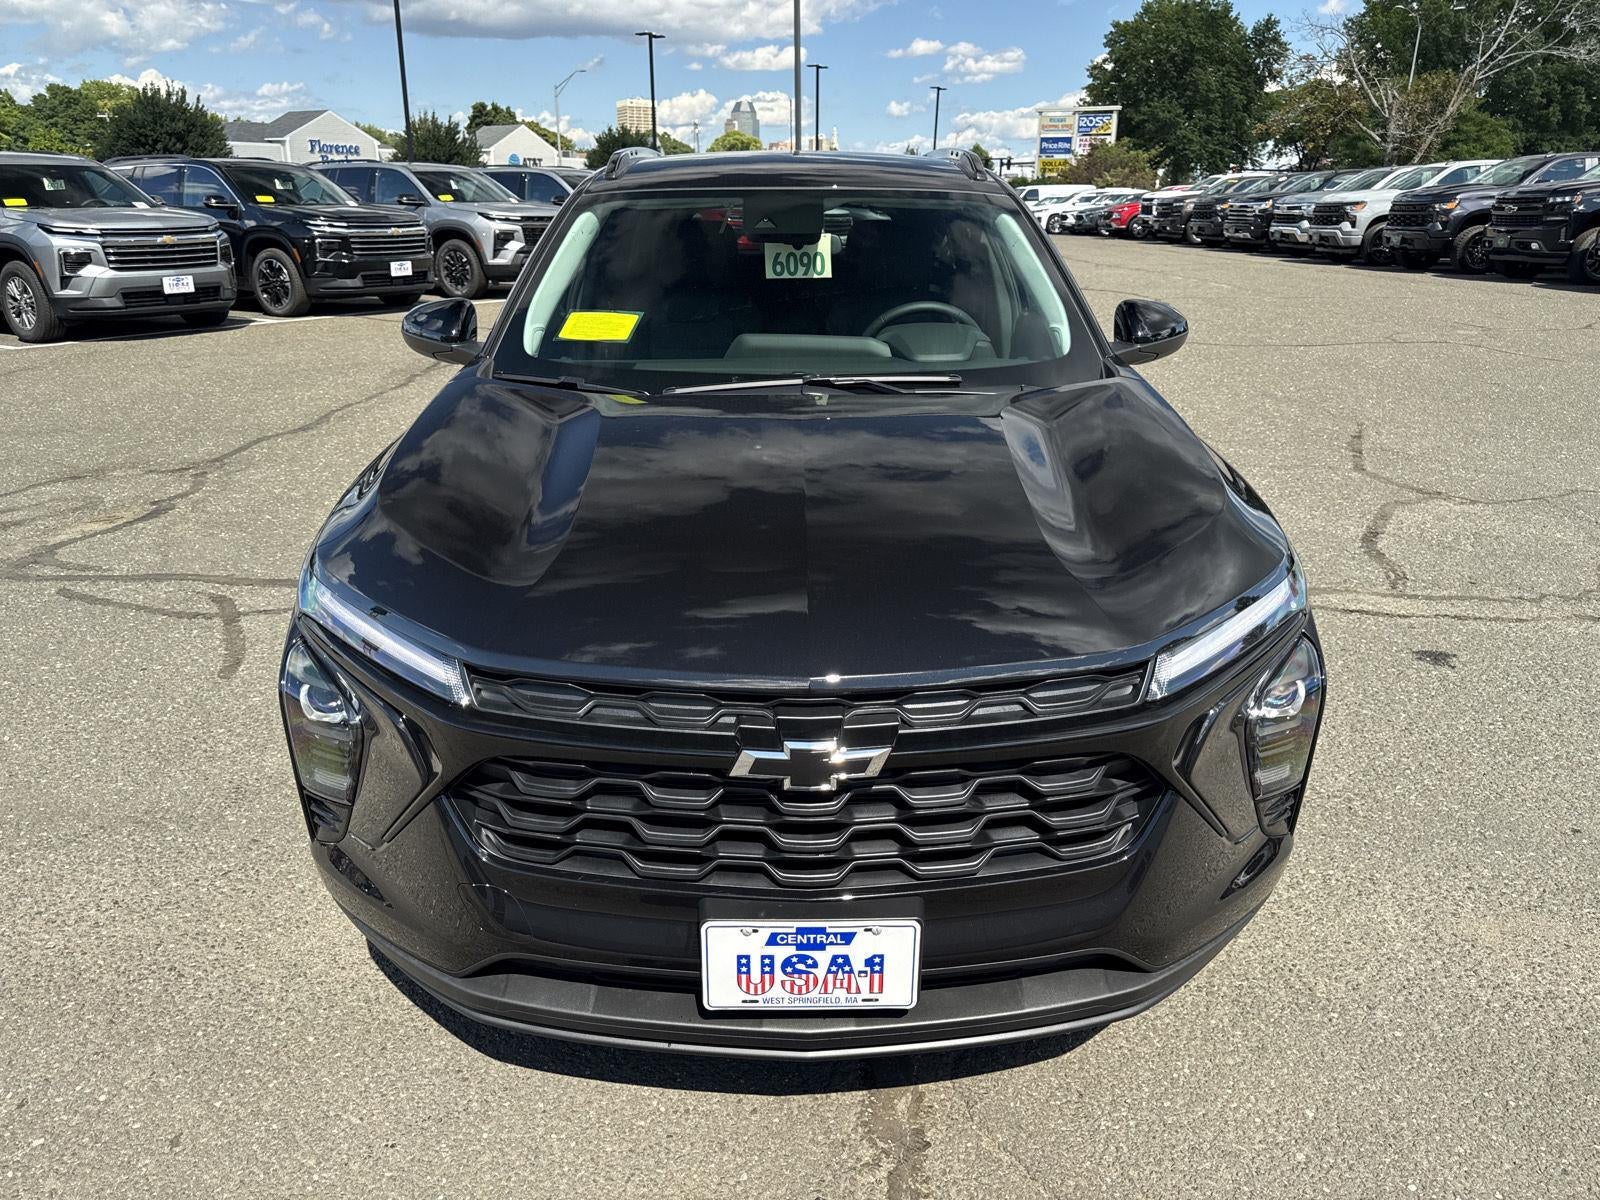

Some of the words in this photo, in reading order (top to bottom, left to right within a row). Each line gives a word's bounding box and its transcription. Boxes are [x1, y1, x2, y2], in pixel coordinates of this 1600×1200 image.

[1079, 117, 1111, 126] ROSS
[308, 139, 361, 155] Florence
[522, 157, 544, 168] AT&T
[772, 251, 826, 276] 6090
[777, 934, 845, 944] CENTRAL
[736, 953, 885, 996] USA-1
[762, 997, 786, 1005] WEST
[845, 996, 859, 1004] MA
